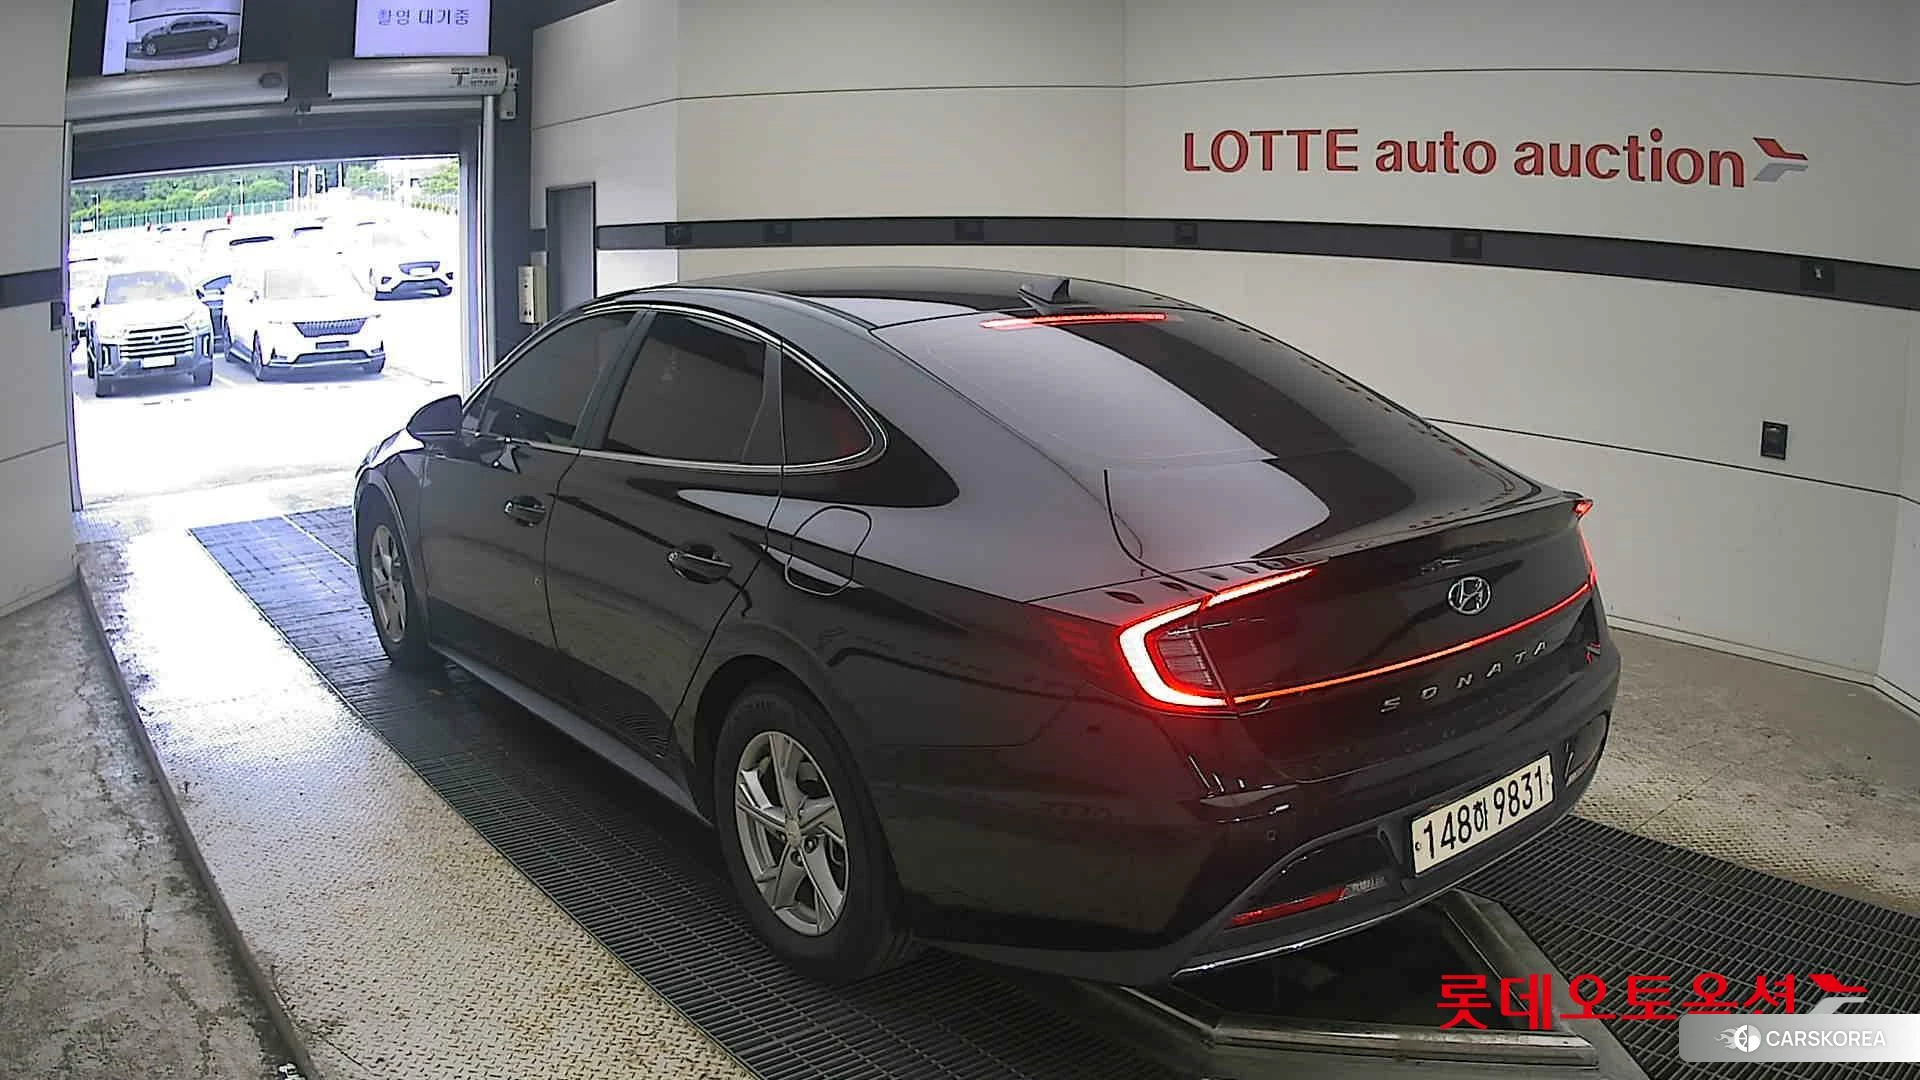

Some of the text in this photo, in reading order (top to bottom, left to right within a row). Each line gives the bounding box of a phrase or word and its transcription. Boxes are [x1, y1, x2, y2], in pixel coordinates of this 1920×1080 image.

[419, 9, 470, 25] 대기중
[1184, 128, 1745, 188] LOTTE auto auction
[1380, 641, 1546, 713] SONATA
[1493, 765, 1544, 825] 9831
